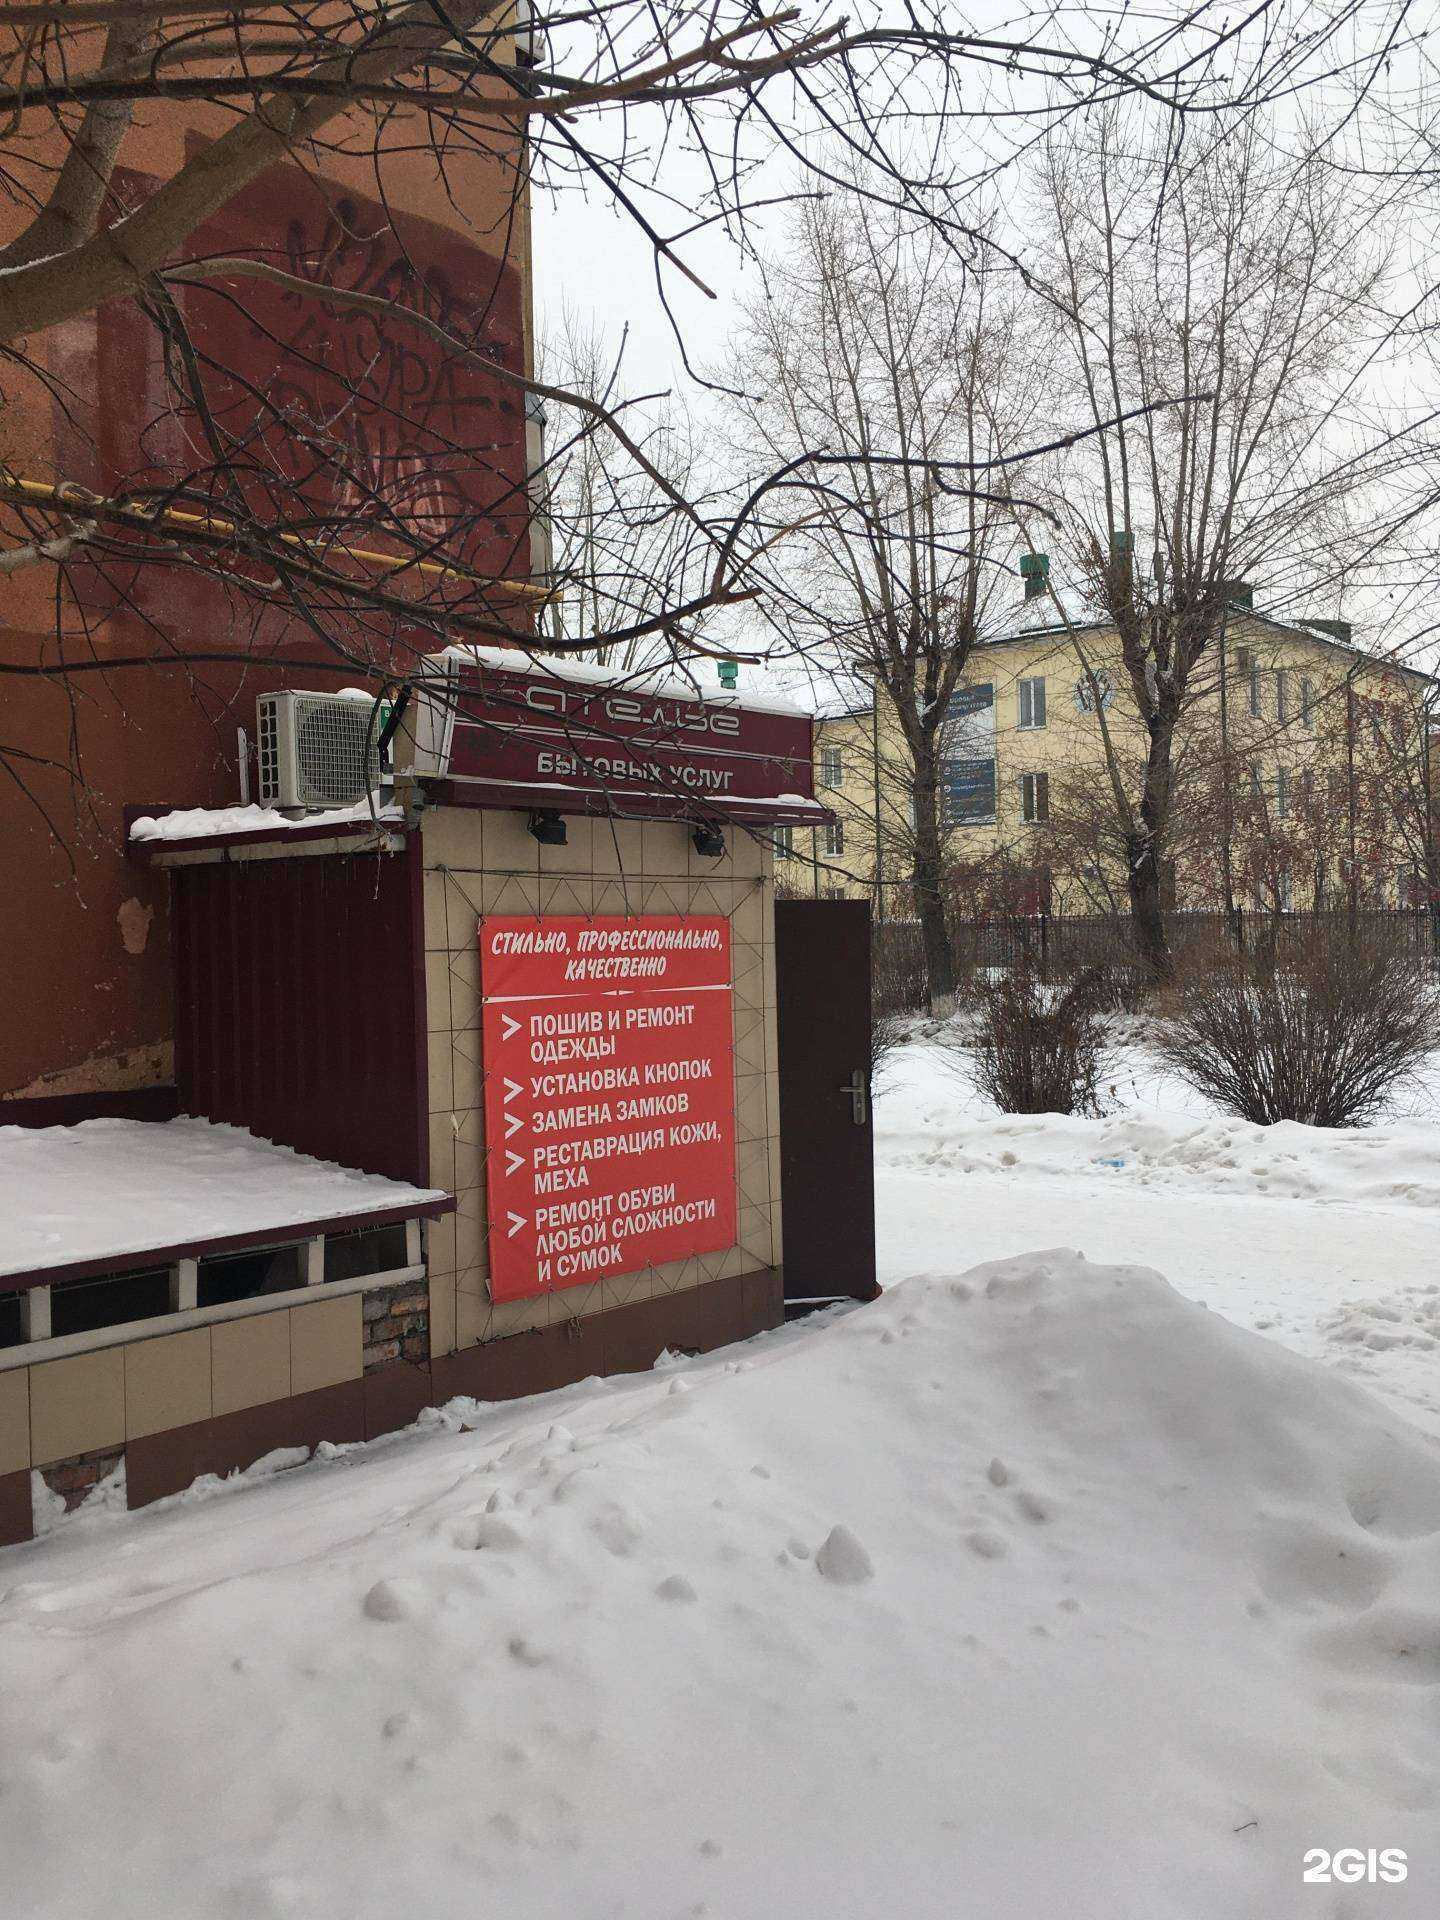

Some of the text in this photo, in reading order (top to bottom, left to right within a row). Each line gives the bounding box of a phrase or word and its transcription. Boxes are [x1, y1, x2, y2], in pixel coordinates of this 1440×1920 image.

[669, 765, 733, 789] УСЛУГ
[491, 929, 723, 955] СТИЛЬНО, ПРОФЕССИОНАЛЬНО,
[564, 956, 667, 981] КАЧЕСТВЕННО
[530, 1005, 695, 1036] ПОШИВ И РЕМОНТ
[530, 1035, 616, 1065] ОДЕЖДЫ
[530, 1058, 712, 1098] УСТАНОВКА КНОПОК
[532, 1093, 689, 1133] ЗАМЕНА ЗАМКОВ
[533, 1121, 722, 1169] РЕСТАВРАЦИЯ КОЖИ,
[534, 1165, 590, 1194] МЕХА
[535, 1183, 675, 1230] РЕМОНТ ОБУВИ
[536, 1199, 715, 1257] ЛЮБОЙ СЛОЖНОСТИ
[537, 1243, 623, 1282] И СУМОК
